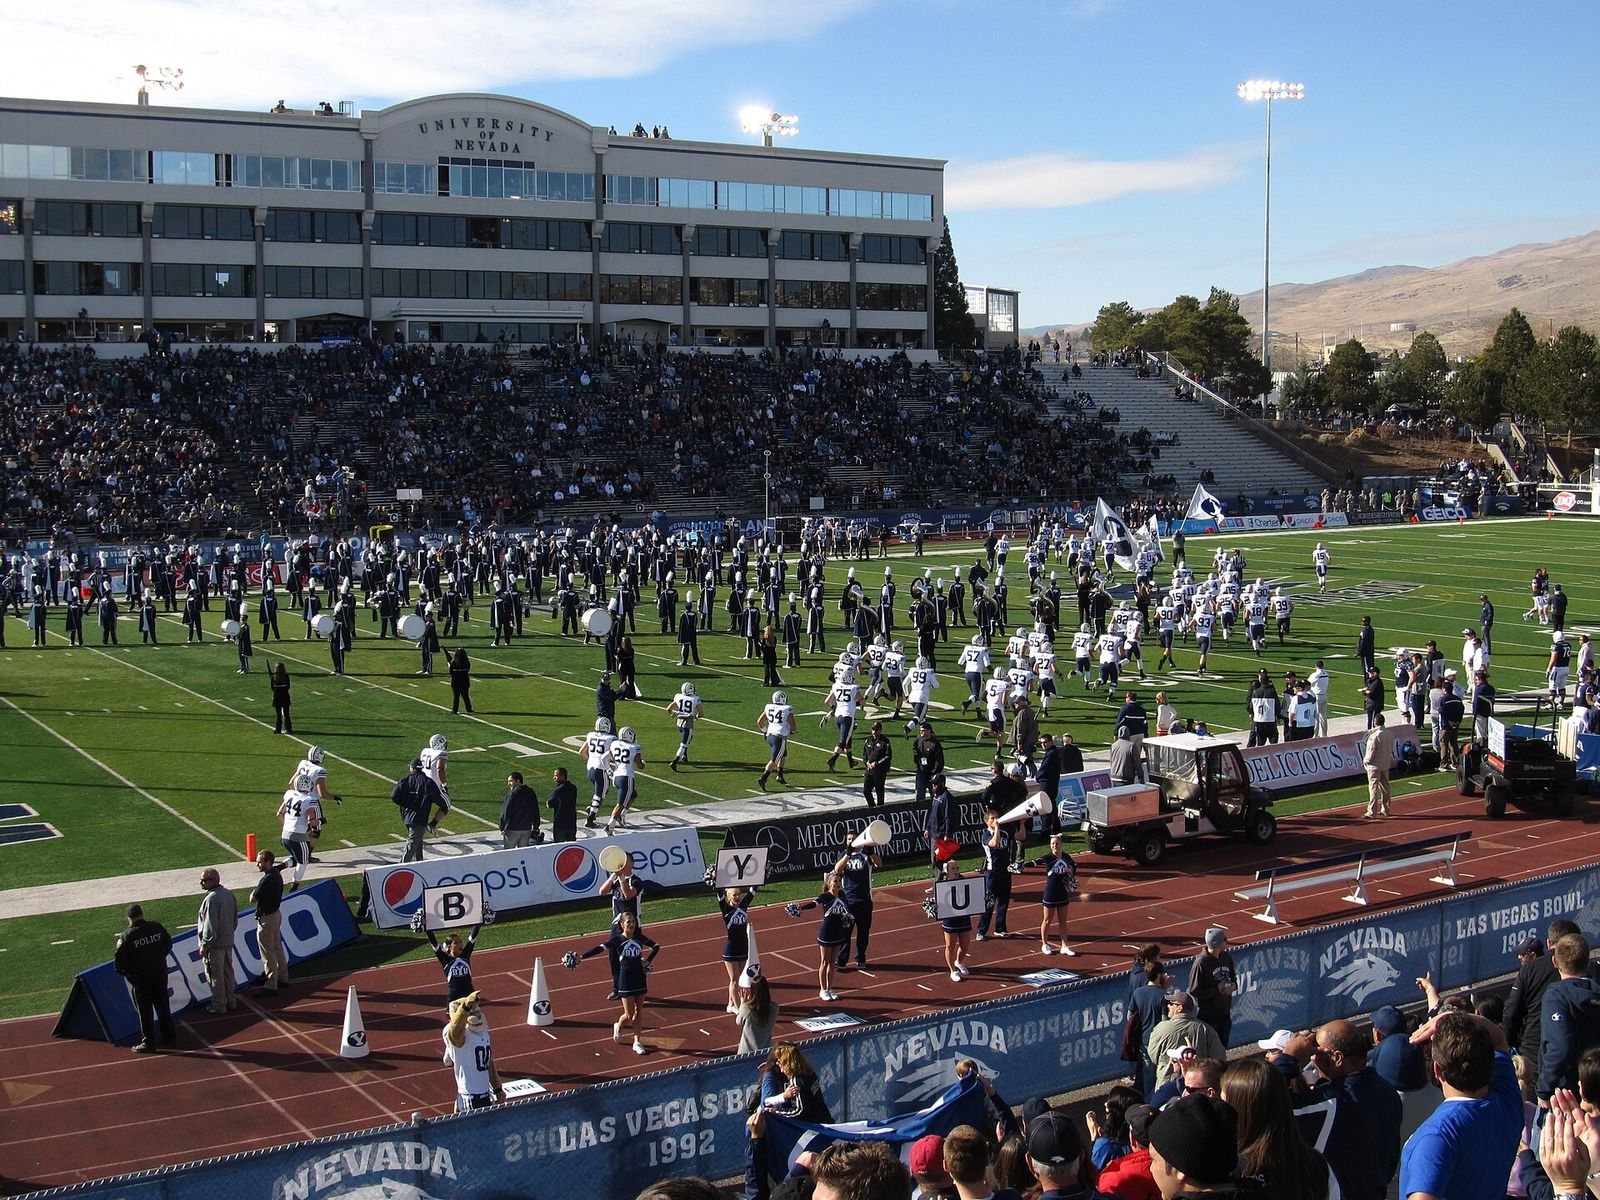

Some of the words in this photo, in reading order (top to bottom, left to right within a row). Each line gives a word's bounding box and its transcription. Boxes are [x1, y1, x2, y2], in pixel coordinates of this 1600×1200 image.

[418, 117, 554, 142] UNIVERSITY
[480, 131, 495, 140] OF
[455, 139, 520, 153] NEVADA
[1328, 516, 1346, 524] pepsi
[1423, 508, 1467, 520] GEICO
[1255, 518, 1278, 526] Charter
[1317, 553, 1325, 561] 15
[1172, 593, 1182, 602] 15
[1258, 589, 1267, 597] 30
[1221, 597, 1231, 606] 25
[1276, 601, 1287, 611] 39
[1161, 610, 1173, 620] 90
[1252, 607, 1262, 617] 18
[1116, 615, 1129, 625] 82
[1198, 618, 1211, 628] 93
[1076, 638, 1087, 648] 27
[1102, 640, 1114, 651] 72
[870, 650, 882, 661] 32
[966, 650, 980, 662] 57
[885, 658, 898, 670] 23
[1038, 659, 1050, 670] 27
[912, 671, 927, 684] 99
[1012, 674, 1027, 687] 33
[836, 689, 851, 703] 75
[990, 685, 998, 697] 5
[678, 700, 693, 714] 19
[768, 709, 783, 724] 54
[589, 738, 605, 755] 55
[614, 748, 631, 764] 22
[1250, 745, 1343, 783] DELICIOUS
[285, 797, 302, 817] 44
[733, 854, 752, 880] Y
[951, 884, 970, 910] U
[443, 891, 466, 921] B
[733, 915, 748, 924] BYU
[1456, 914, 1488, 940] LAS
[1491, 901, 1540, 931] VEGAS
[1543, 890, 1585, 918] BOWL
[133, 932, 162, 949] POLICE
[625, 946, 641, 958] BYU
[1319, 927, 1407, 978] NEVADA
[452, 965, 468, 978] BYU
[1082, 1000, 1123, 1032] LAS
[884, 1021, 1008, 1083] NEVADA
[559, 1117, 616, 1153] LAS
[626, 1093, 718, 1137] VEGAS
[649, 1129, 715, 1167] 1992
[284, 1141, 457, 1200] NEVADA
